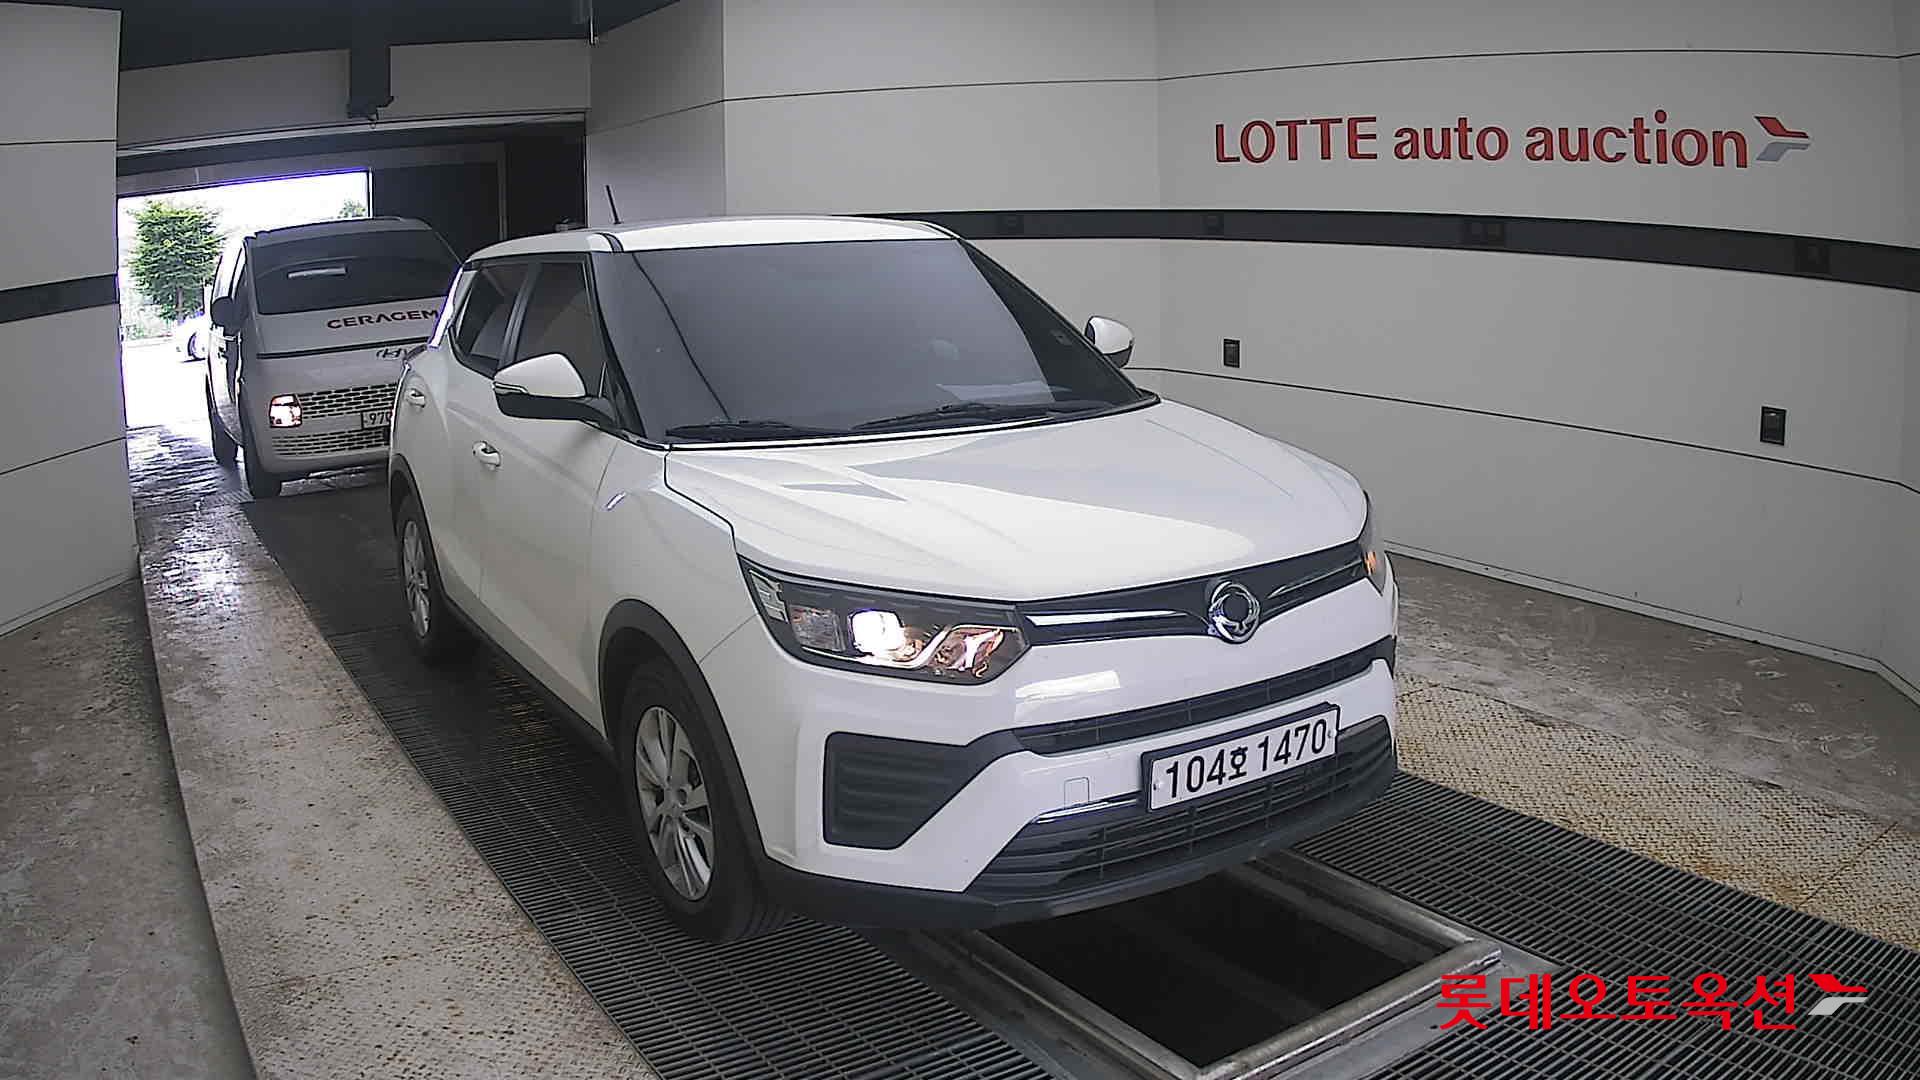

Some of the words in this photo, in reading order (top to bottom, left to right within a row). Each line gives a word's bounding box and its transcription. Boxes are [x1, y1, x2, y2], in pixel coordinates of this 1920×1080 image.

[1214, 116, 1378, 163] LOTTE
[1392, 116, 1510, 162] auto
[1524, 109, 1749, 169] auction
[327, 310, 438, 329] CERAGEM
[1166, 746, 1248, 799] 104호
[1257, 718, 1327, 772] 1470
